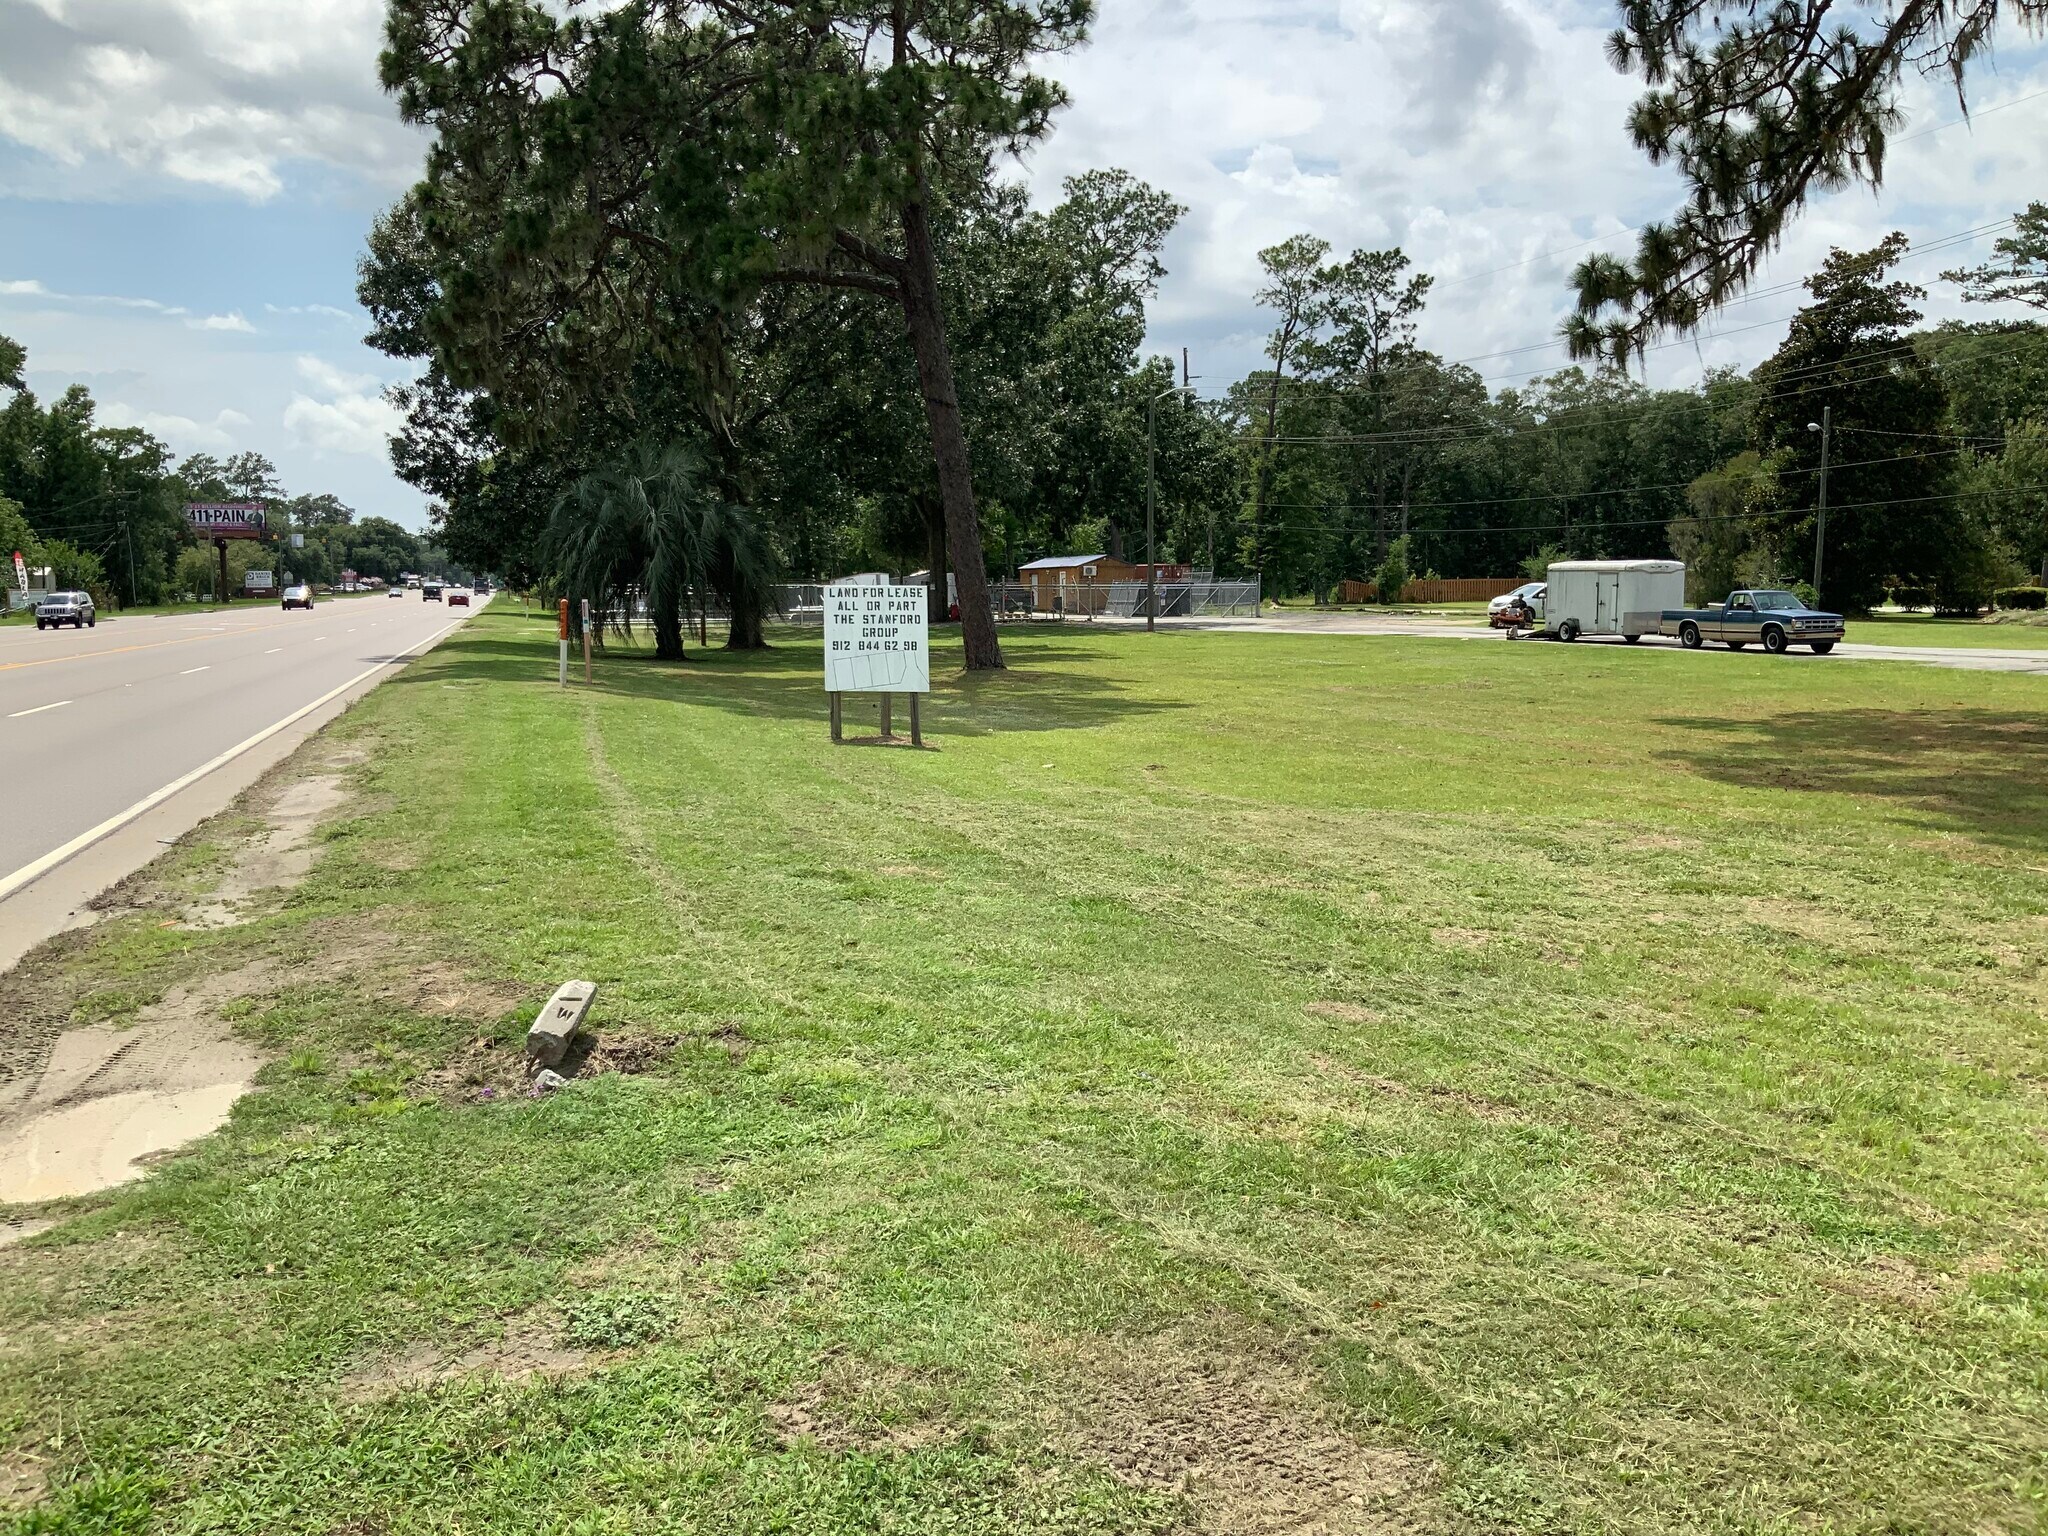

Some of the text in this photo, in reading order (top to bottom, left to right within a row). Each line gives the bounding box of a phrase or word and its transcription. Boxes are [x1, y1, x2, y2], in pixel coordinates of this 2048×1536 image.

[829, 587, 923, 598] LAND FOR LEASE
[837, 600, 917, 611] ALL OR PART
[833, 614, 921, 624] THE STANFORD
[862, 627, 899, 638] GROUP
[832, 640, 851, 651] 912
[858, 640, 880, 651] 844
[903, 640, 918, 651] 98
